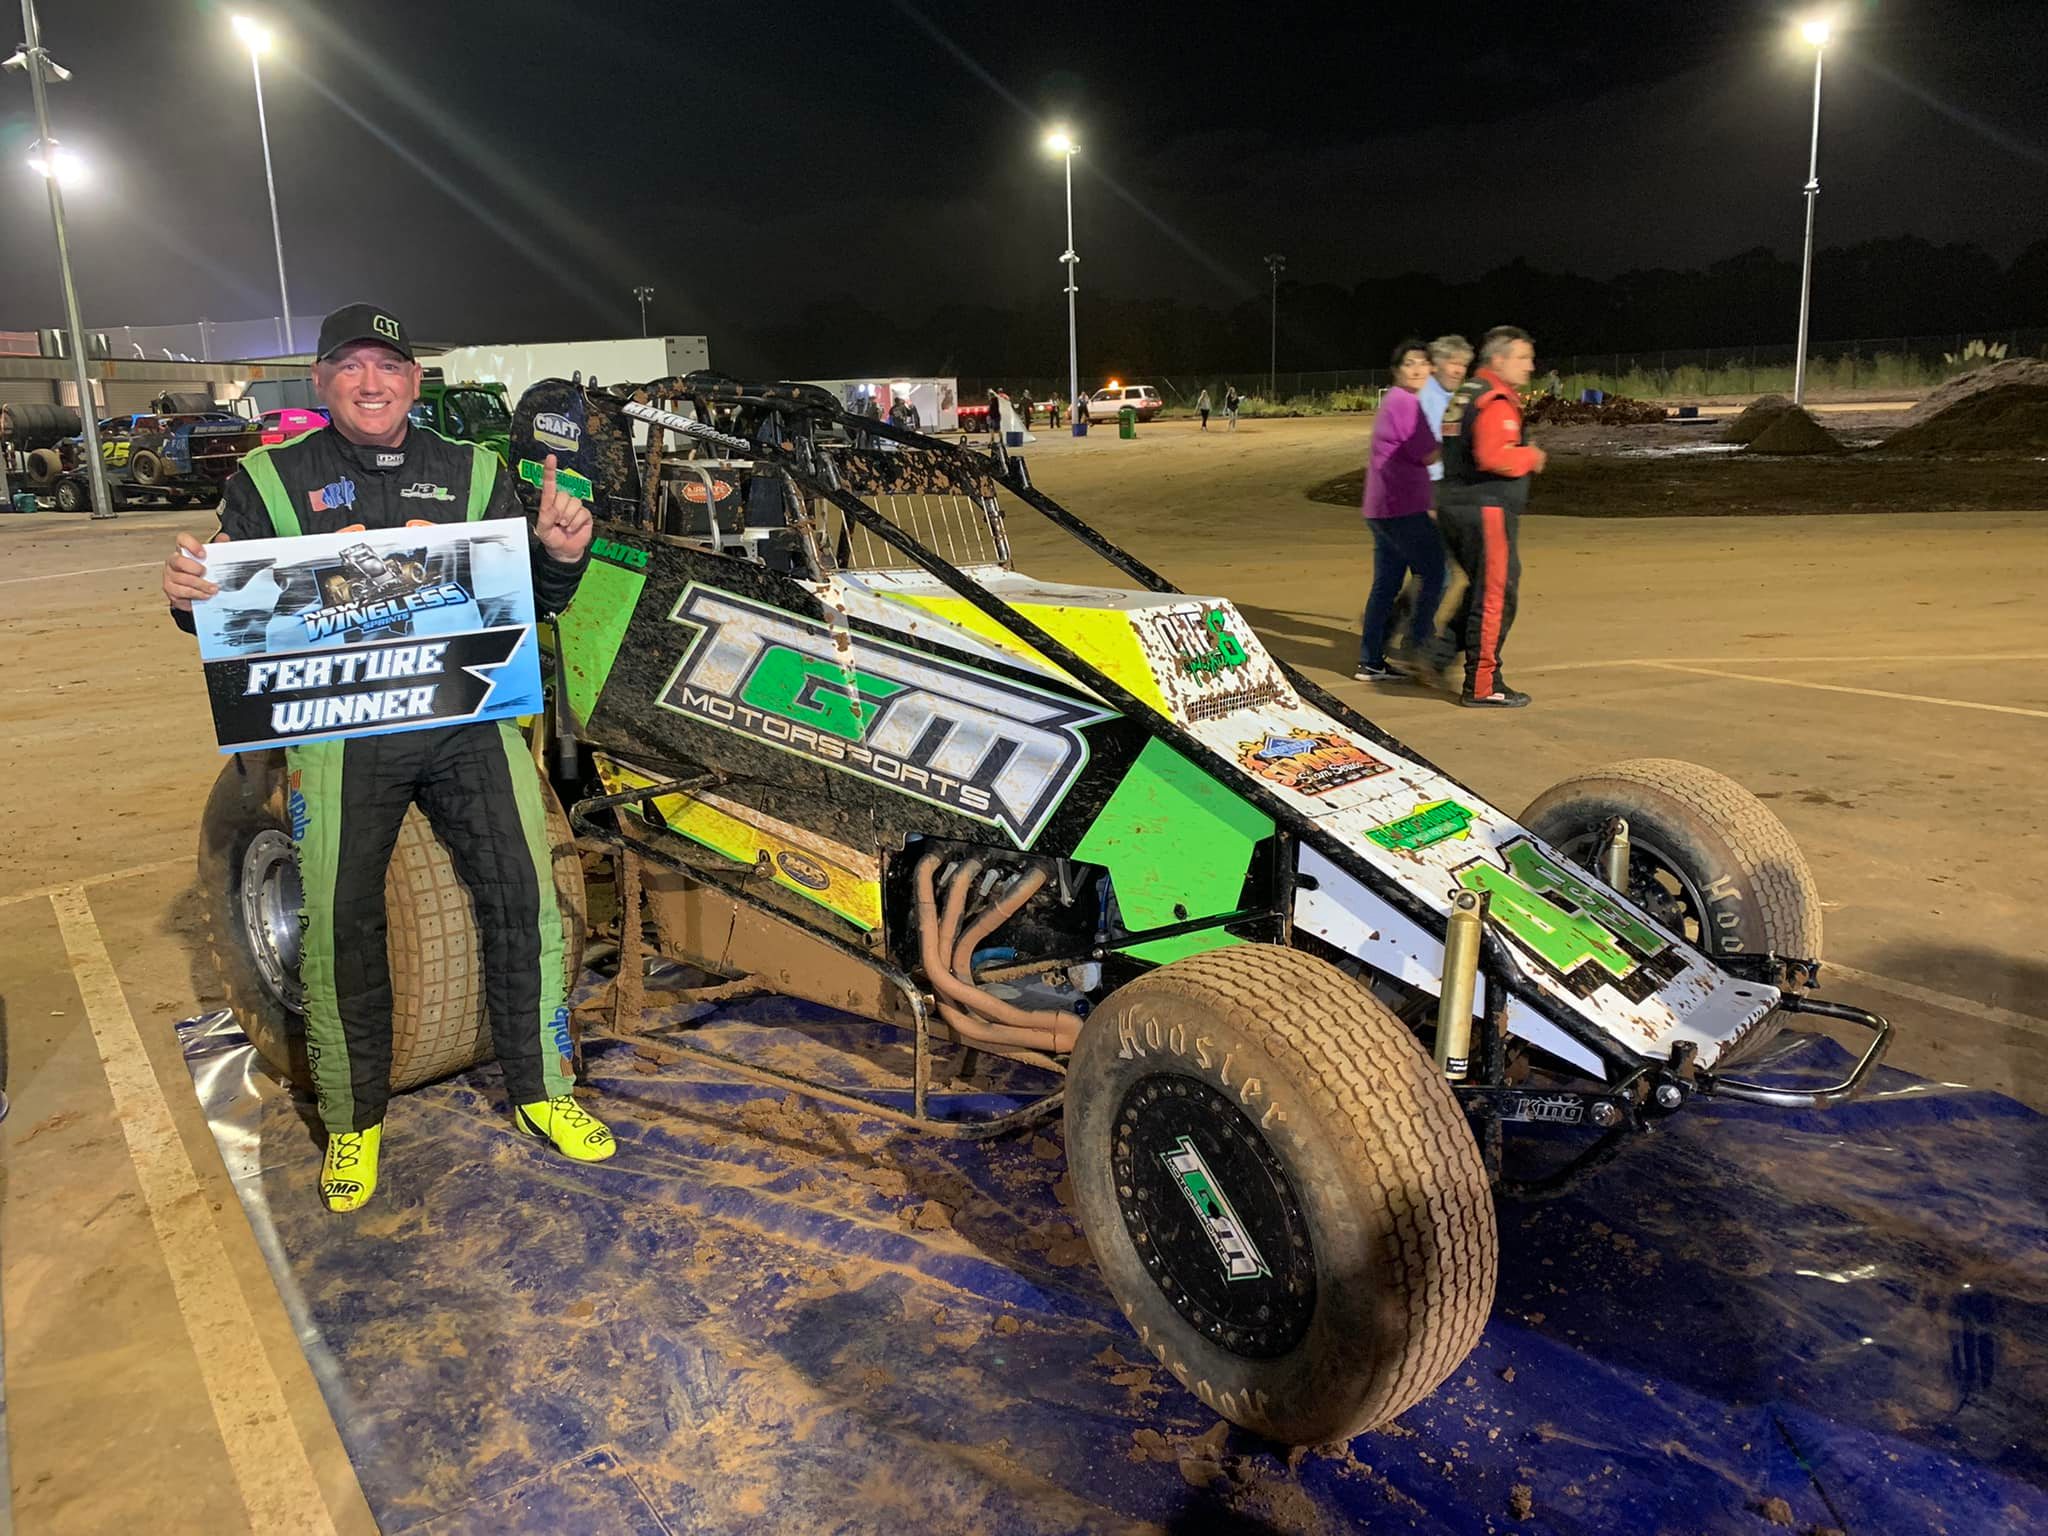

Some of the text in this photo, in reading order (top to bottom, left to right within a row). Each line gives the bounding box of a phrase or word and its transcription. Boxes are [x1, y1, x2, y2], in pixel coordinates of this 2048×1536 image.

[374, 314, 399, 340] 41
[535, 414, 579, 439] CRAFT
[591, 537, 650, 568] BATES
[304, 602, 361, 620] NSW
[305, 584, 469, 641] WINGLESS
[363, 614, 409, 629] SPRINTS
[242, 641, 450, 696] FEATURE
[271, 684, 439, 734] WINNER
[681, 686, 992, 812] MOTORSPORTS
[1518, 1098, 1585, 1124] King
[324, 1182, 360, 1195] OMP
[1166, 1157, 1232, 1264] MOTORSPORTS
